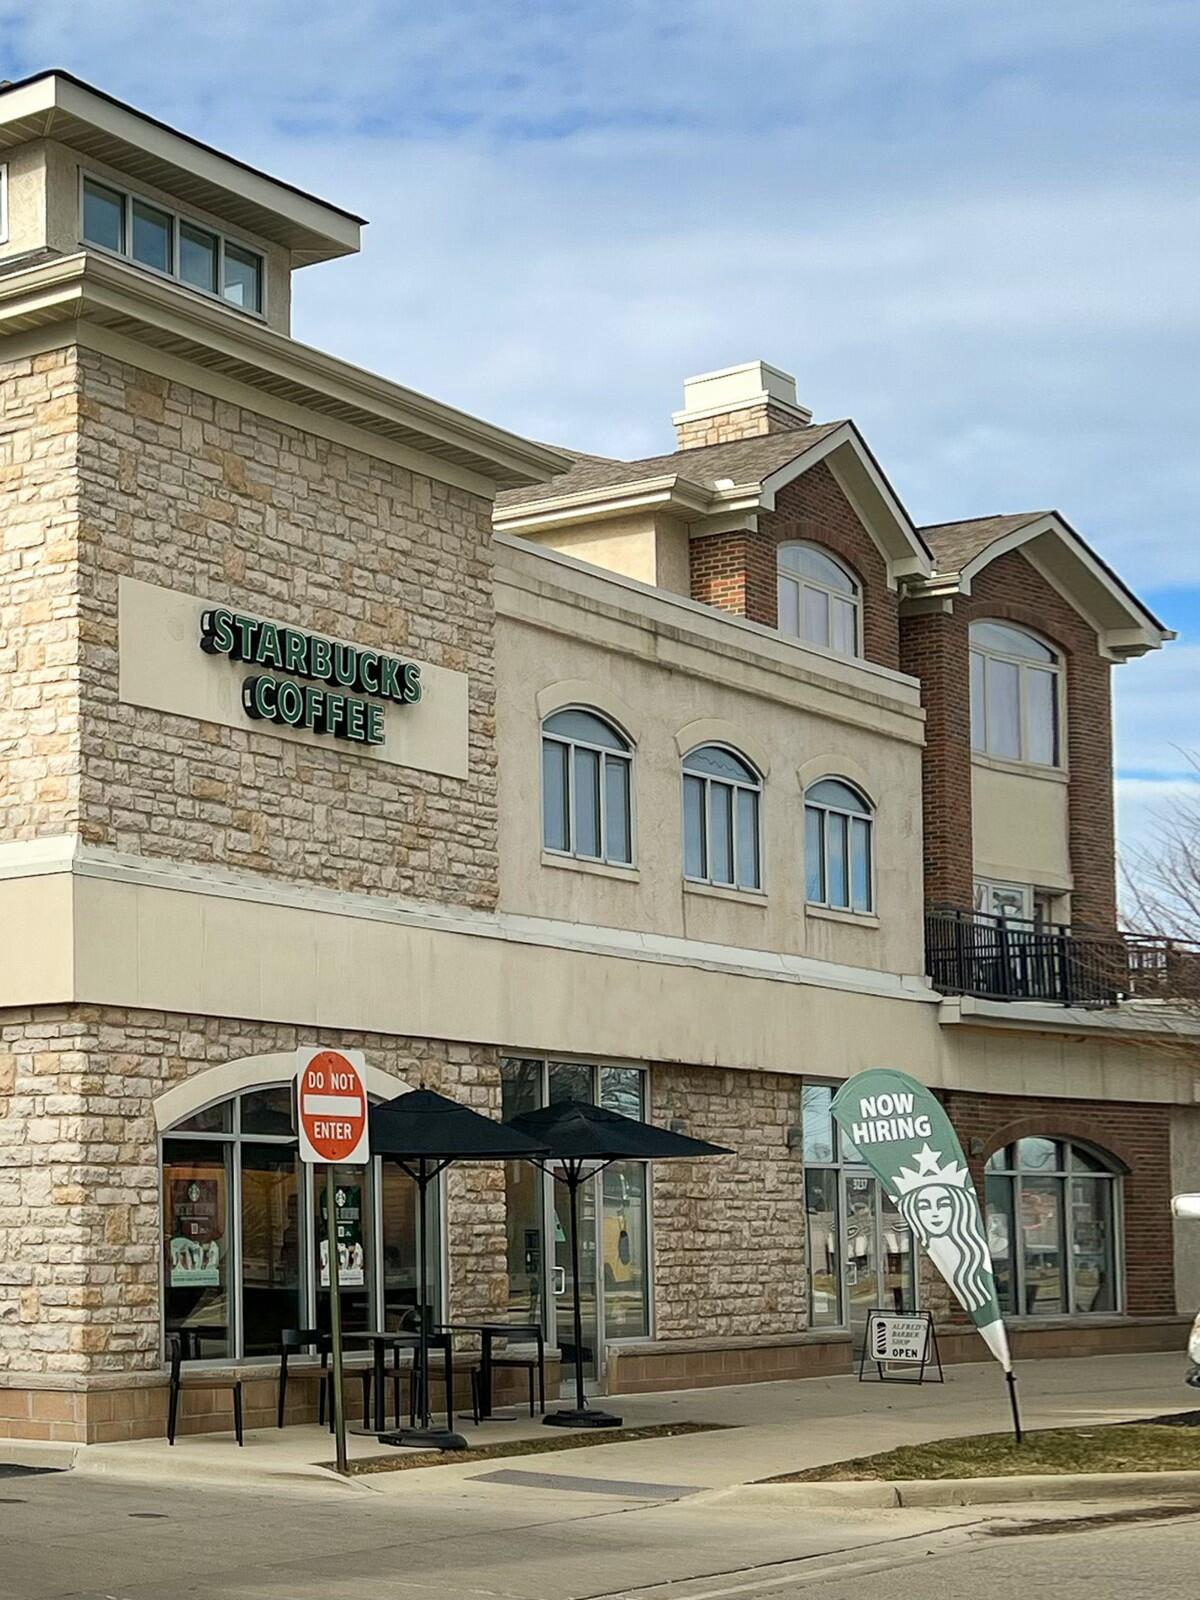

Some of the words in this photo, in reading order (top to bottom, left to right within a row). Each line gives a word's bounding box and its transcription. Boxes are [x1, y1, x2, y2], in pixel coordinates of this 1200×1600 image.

[209, 608, 423, 704] STARBUCKS
[250, 675, 386, 745] COFFEE
[308, 1071, 324, 1089] DO
[330, 1073, 355, 1090] NOT
[860, 1093, 913, 1118] NOW
[313, 1121, 352, 1140] ENTER
[852, 1115, 932, 1145] HIRING
[892, 1348, 918, 1358] OPEN
